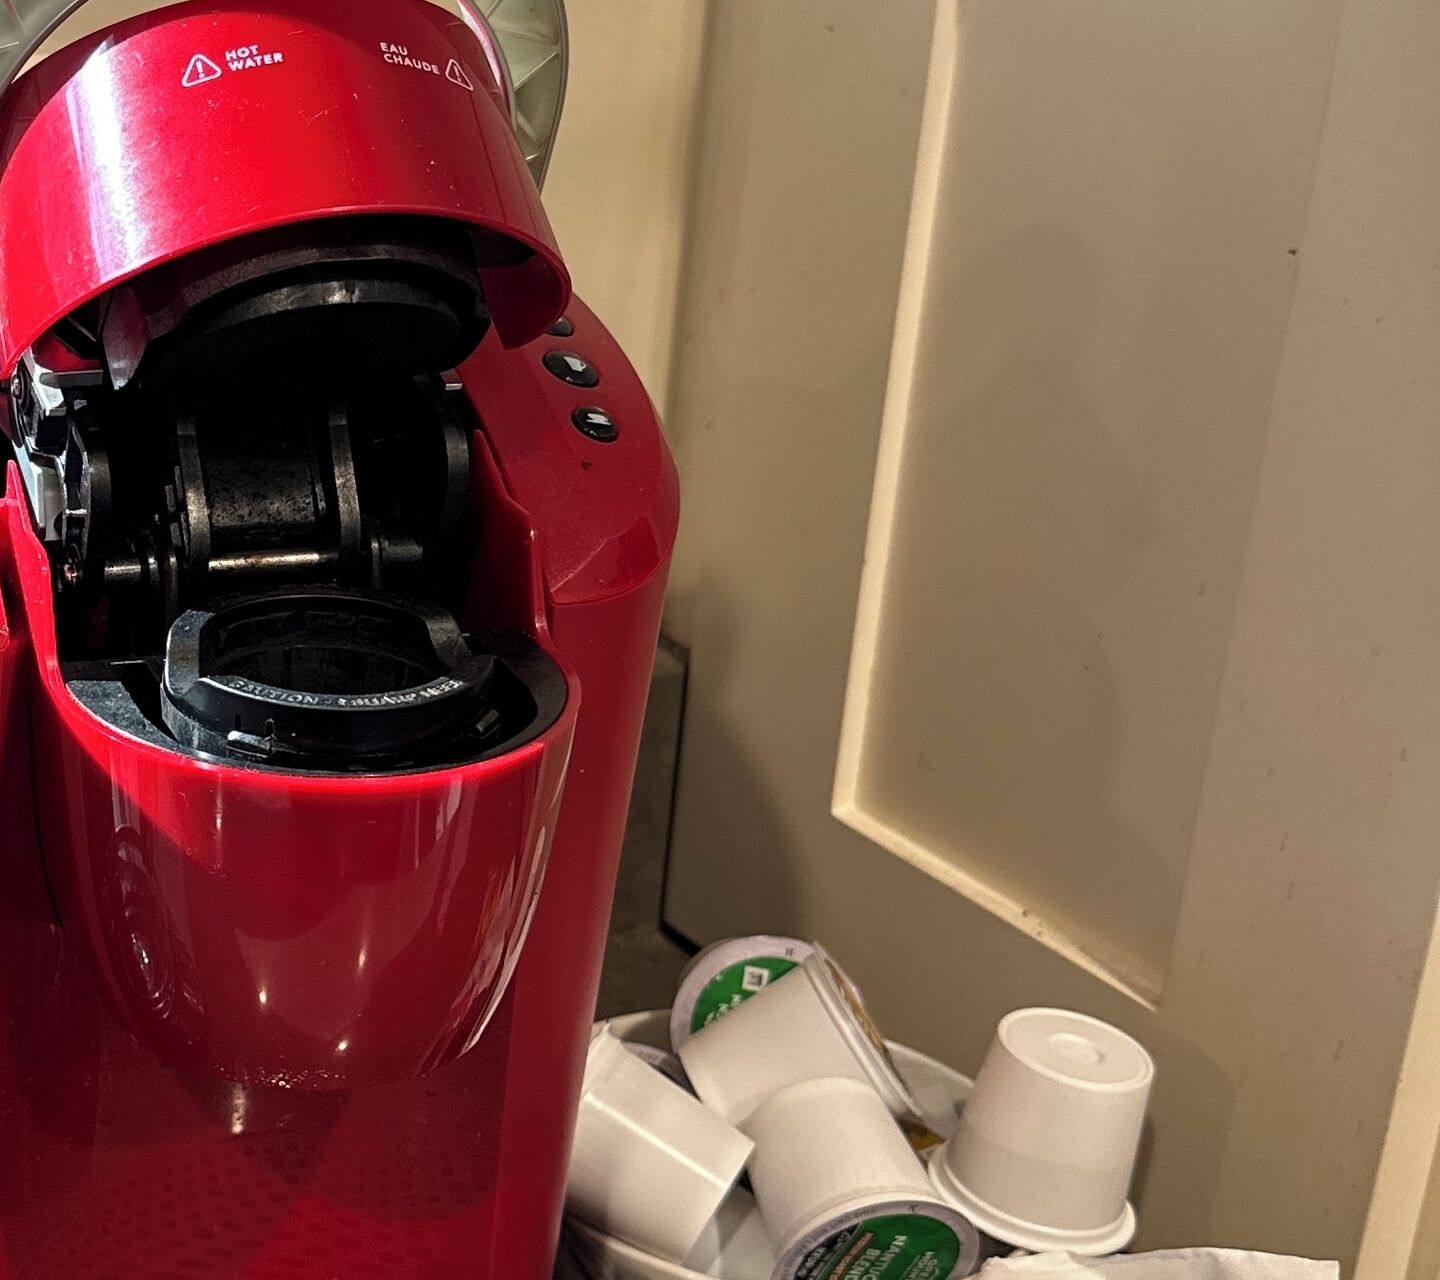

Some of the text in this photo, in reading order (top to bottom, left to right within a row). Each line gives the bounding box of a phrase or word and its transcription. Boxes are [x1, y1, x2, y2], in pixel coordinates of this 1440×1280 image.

[224, 44, 260, 61] HOT
[380, 42, 408, 56] EAU
[227, 52, 284, 72] WATER
[383, 53, 440, 75] CHAUDE
